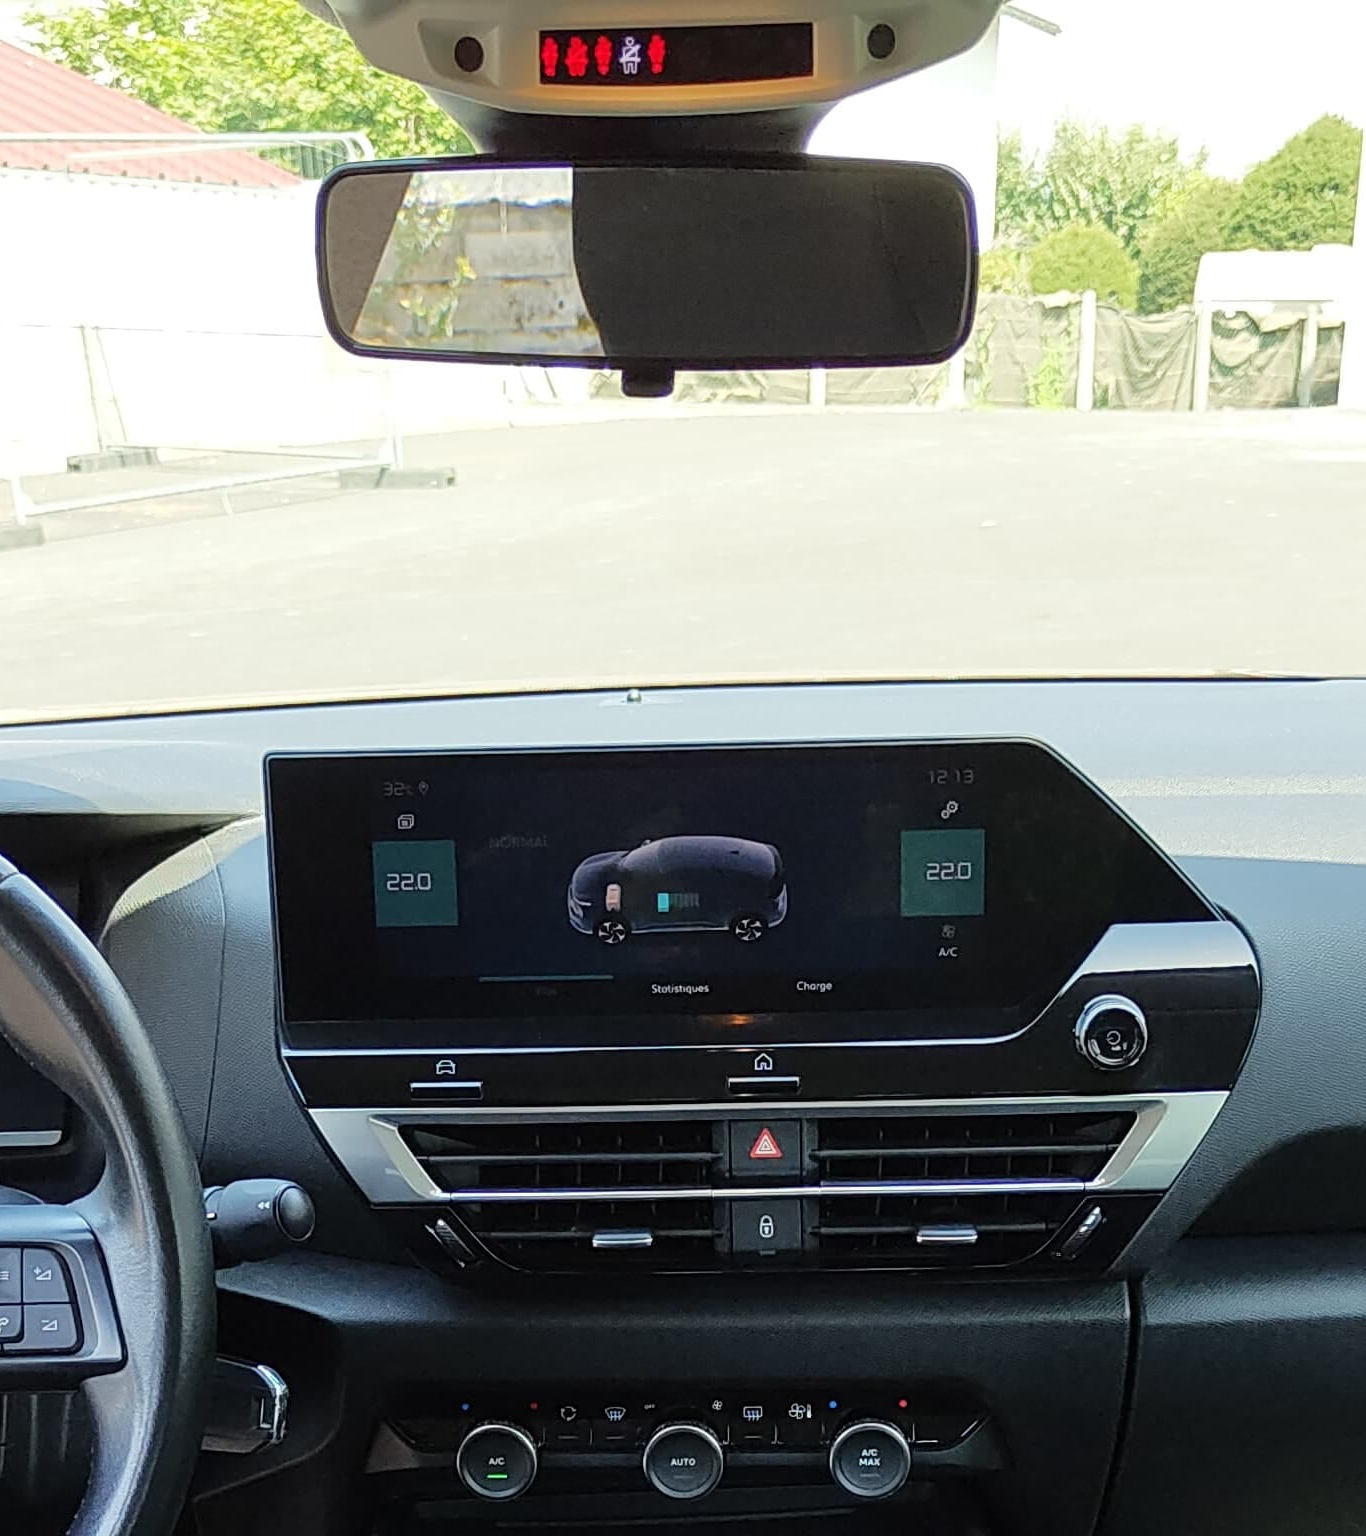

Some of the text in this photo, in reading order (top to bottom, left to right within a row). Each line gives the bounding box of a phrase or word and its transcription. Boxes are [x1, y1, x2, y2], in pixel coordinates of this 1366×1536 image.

[926, 862, 972, 881] 22.0
[386, 872, 432, 891] 22.0
[938, 947, 959, 957] A/C
[651, 983, 710, 996] Statistiques
[796, 980, 833, 993] Charge
[861, 1449, 878, 1458] A/C
[488, 1456, 506, 1466] A/C
[670, 1457, 696, 1467] AUTO
[859, 1458, 881, 1467] MAX
